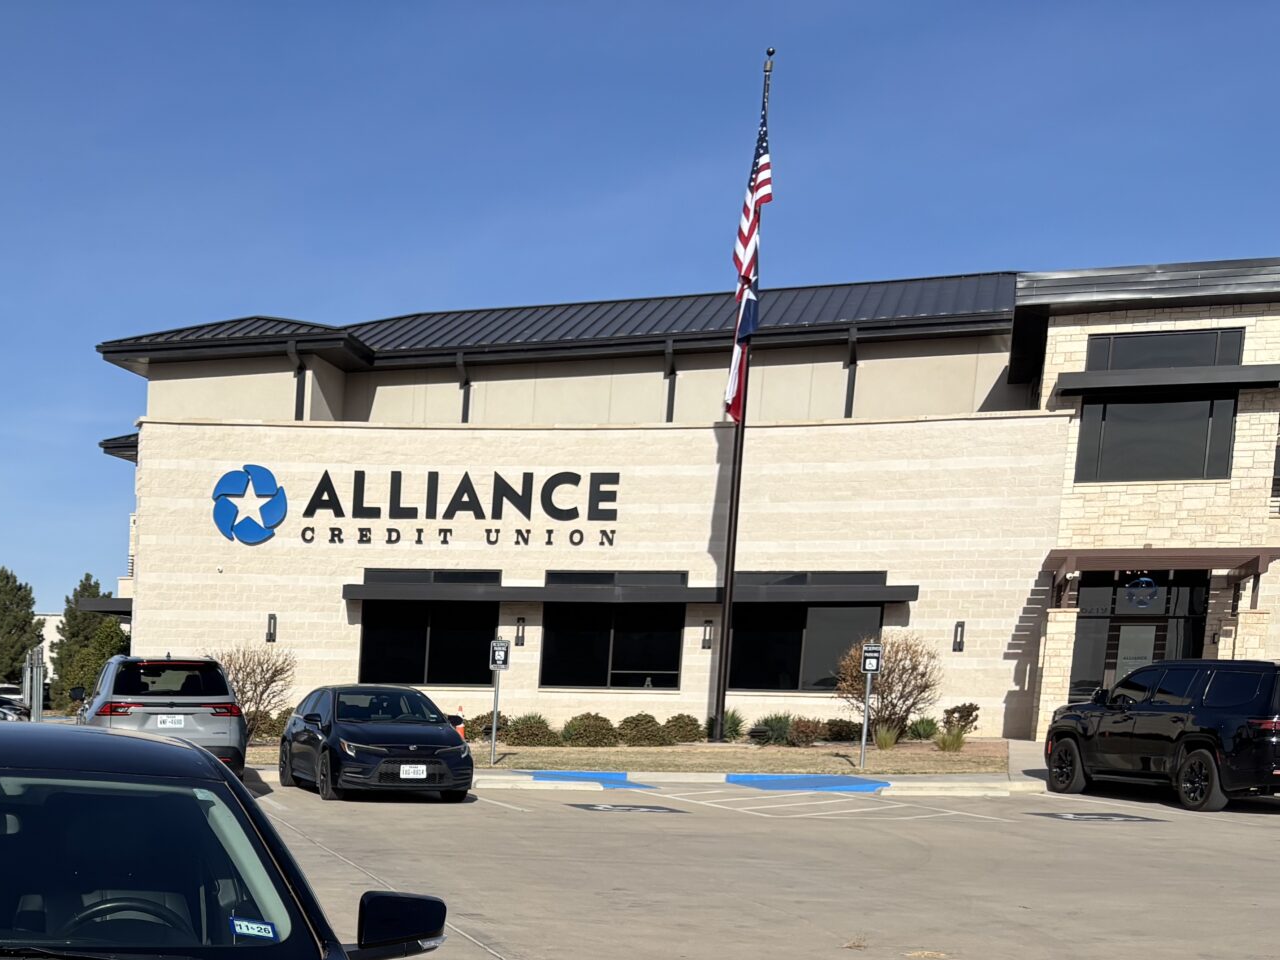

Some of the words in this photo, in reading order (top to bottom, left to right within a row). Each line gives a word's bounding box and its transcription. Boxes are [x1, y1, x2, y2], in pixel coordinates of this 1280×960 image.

[302, 469, 620, 521] ALLIANCE
[301, 526, 452, 545] CREDIT
[485, 528, 616, 546] UNION
